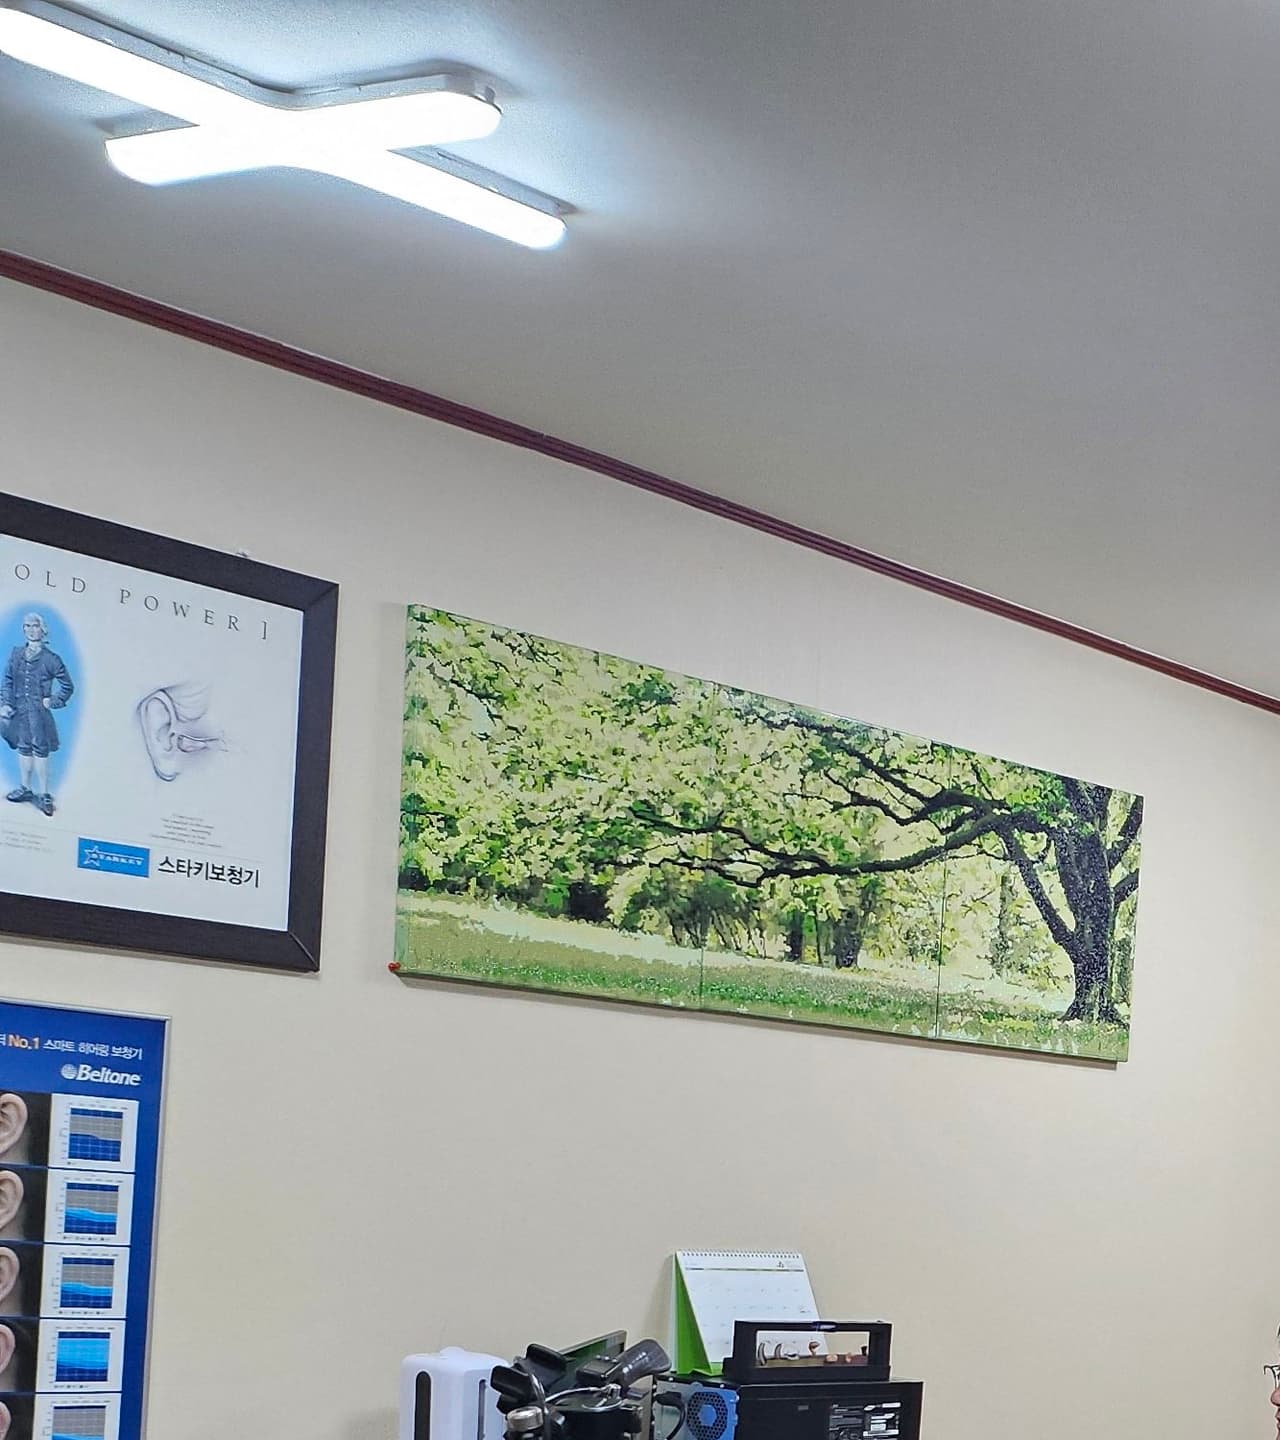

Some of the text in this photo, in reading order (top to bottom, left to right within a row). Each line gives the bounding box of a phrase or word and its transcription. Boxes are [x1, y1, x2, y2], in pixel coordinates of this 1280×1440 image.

[119, 588, 240, 631] POWER
[157, 855, 260, 888] 스타키보청기
[8, 1034, 40, 1050] No.1
[42, 1039, 77, 1053] 스마트
[78, 1041, 109, 1057] 히어링
[111, 1046, 143, 1061] 보청기
[76, 1064, 141, 1086] Beltone
